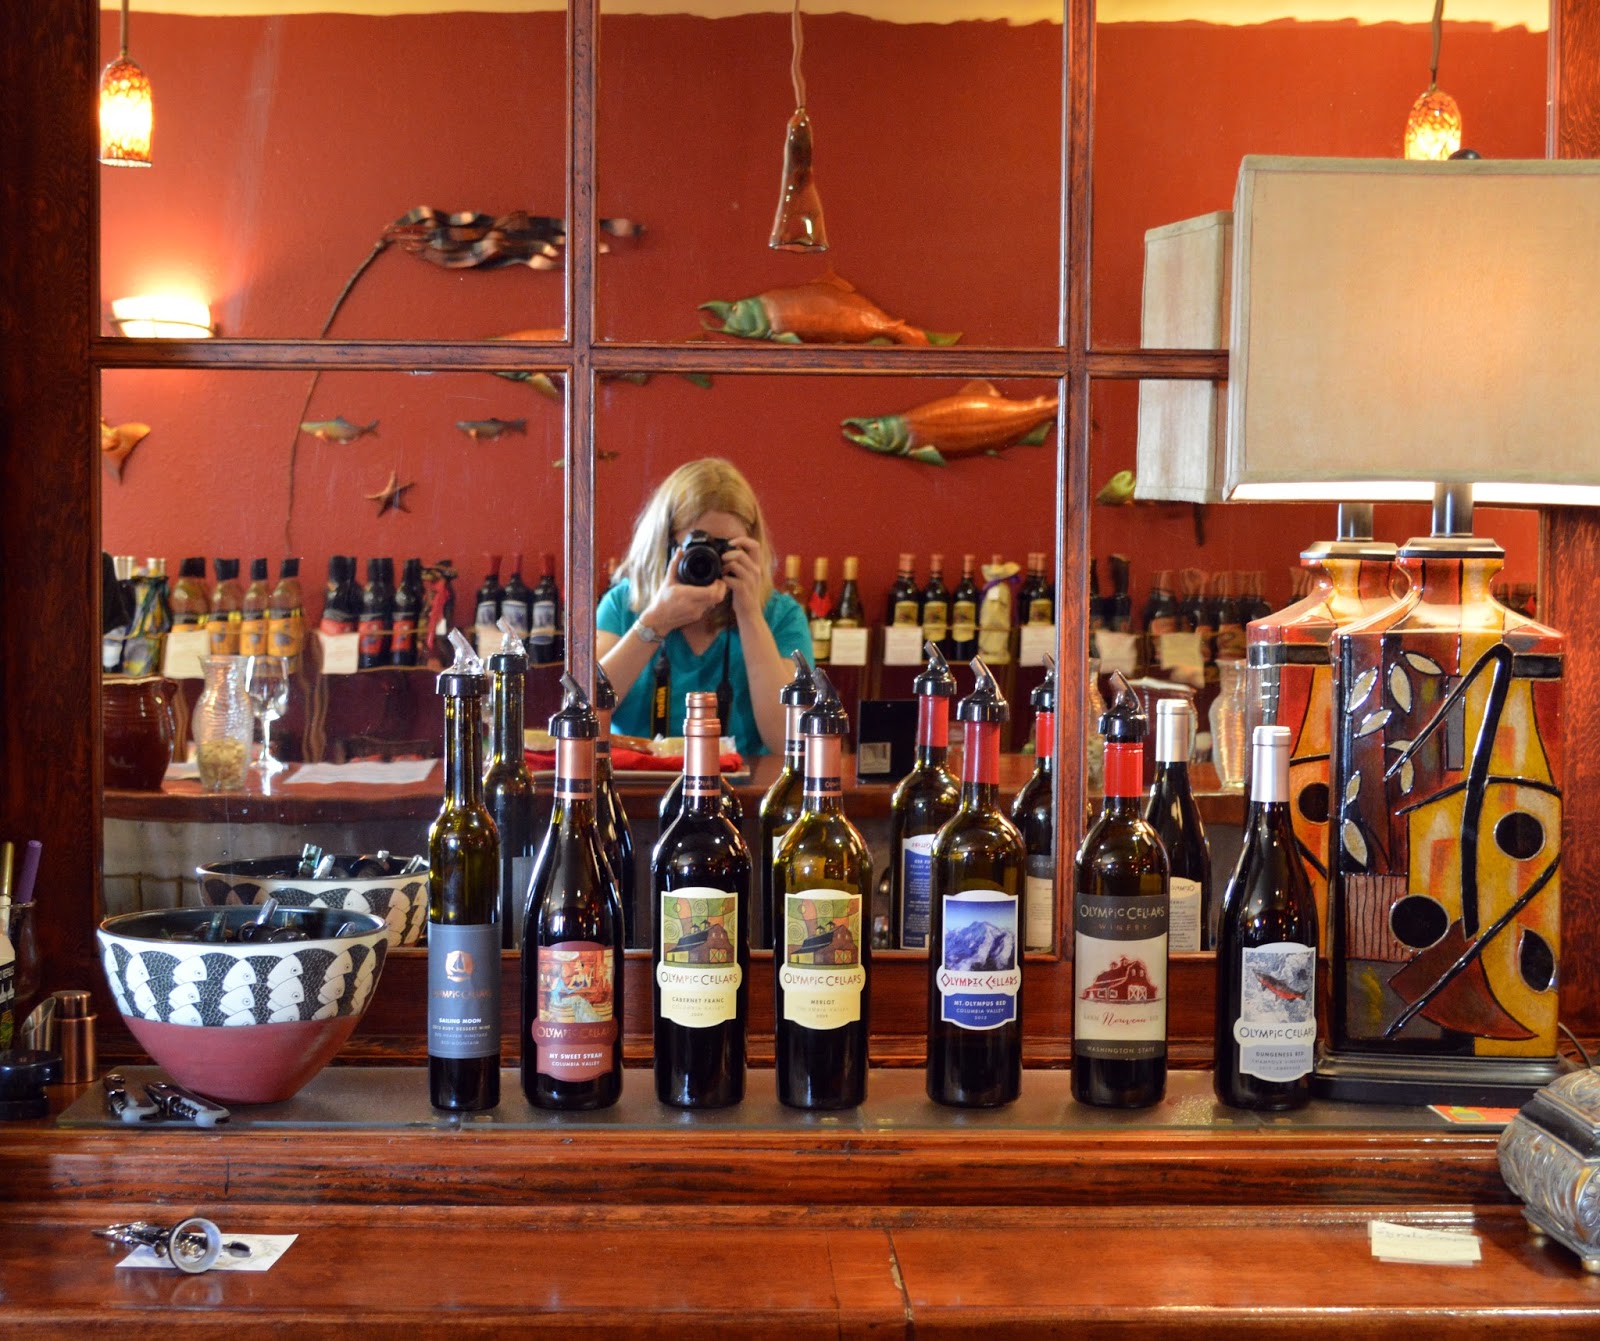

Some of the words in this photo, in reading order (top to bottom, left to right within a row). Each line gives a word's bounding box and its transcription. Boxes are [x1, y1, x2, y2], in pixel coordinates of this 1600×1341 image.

[1080, 904, 1125, 919] OLYMPIC
[1126, 906, 1165, 920] CELLARS
[661, 970, 699, 985] OLYMPIC
[700, 973, 738, 986] CELLARS
[784, 972, 824, 986] OLYMPIC
[825, 974, 862, 987] CELLARS
[941, 973, 983, 988] OLYMPIC
[985, 975, 1018, 990] CELLARS
[432, 989, 460, 999] MPIC
[671, 996, 702, 1004] CABERNET
[439, 1017, 461, 1025] SAILING
[462, 1017, 482, 1025] MOON
[537, 1026, 578, 1039] OLYMPIC
[1239, 1026, 1284, 1039] OLYMPIC
[1284, 1026, 1315, 1040] CELLARS
[1087, 1045, 1135, 1054] WASHINGTON
[1137, 1046, 1156, 1054] STATE
[548, 1052, 559, 1060] MY
[560, 1052, 581, 1060] SWEET
[583, 1052, 603, 1060] SYRAH
[551, 1060, 580, 1068] COLUMBIA
